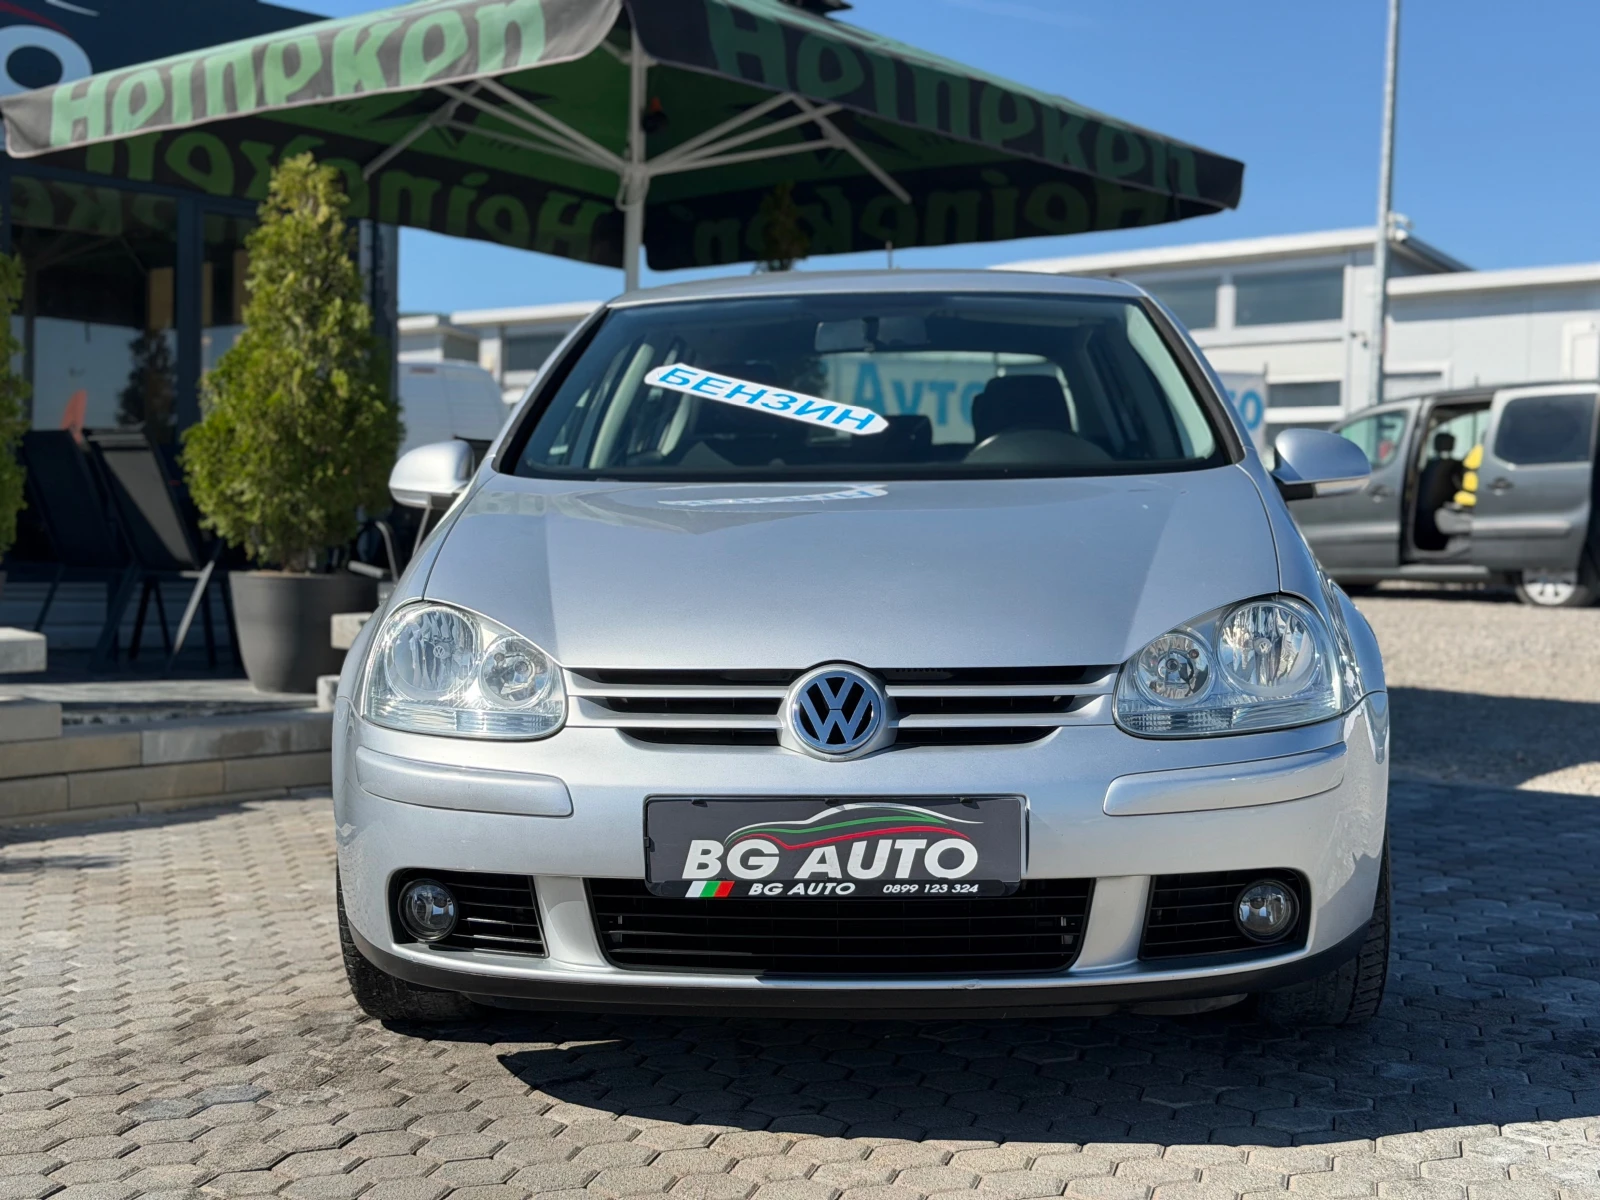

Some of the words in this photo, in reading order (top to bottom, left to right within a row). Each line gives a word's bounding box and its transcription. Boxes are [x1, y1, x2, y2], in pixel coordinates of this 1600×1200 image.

[659, 367, 876, 431] БЕНЗИН
[682, 838, 780, 880] BG
[794, 838, 979, 880] AUTO
[748, 882, 784, 896] BG
[787, 882, 856, 896] AUTO
[883, 883, 918, 895] 0899
[924, 883, 948, 894] 123
[952, 883, 979, 894] 324
